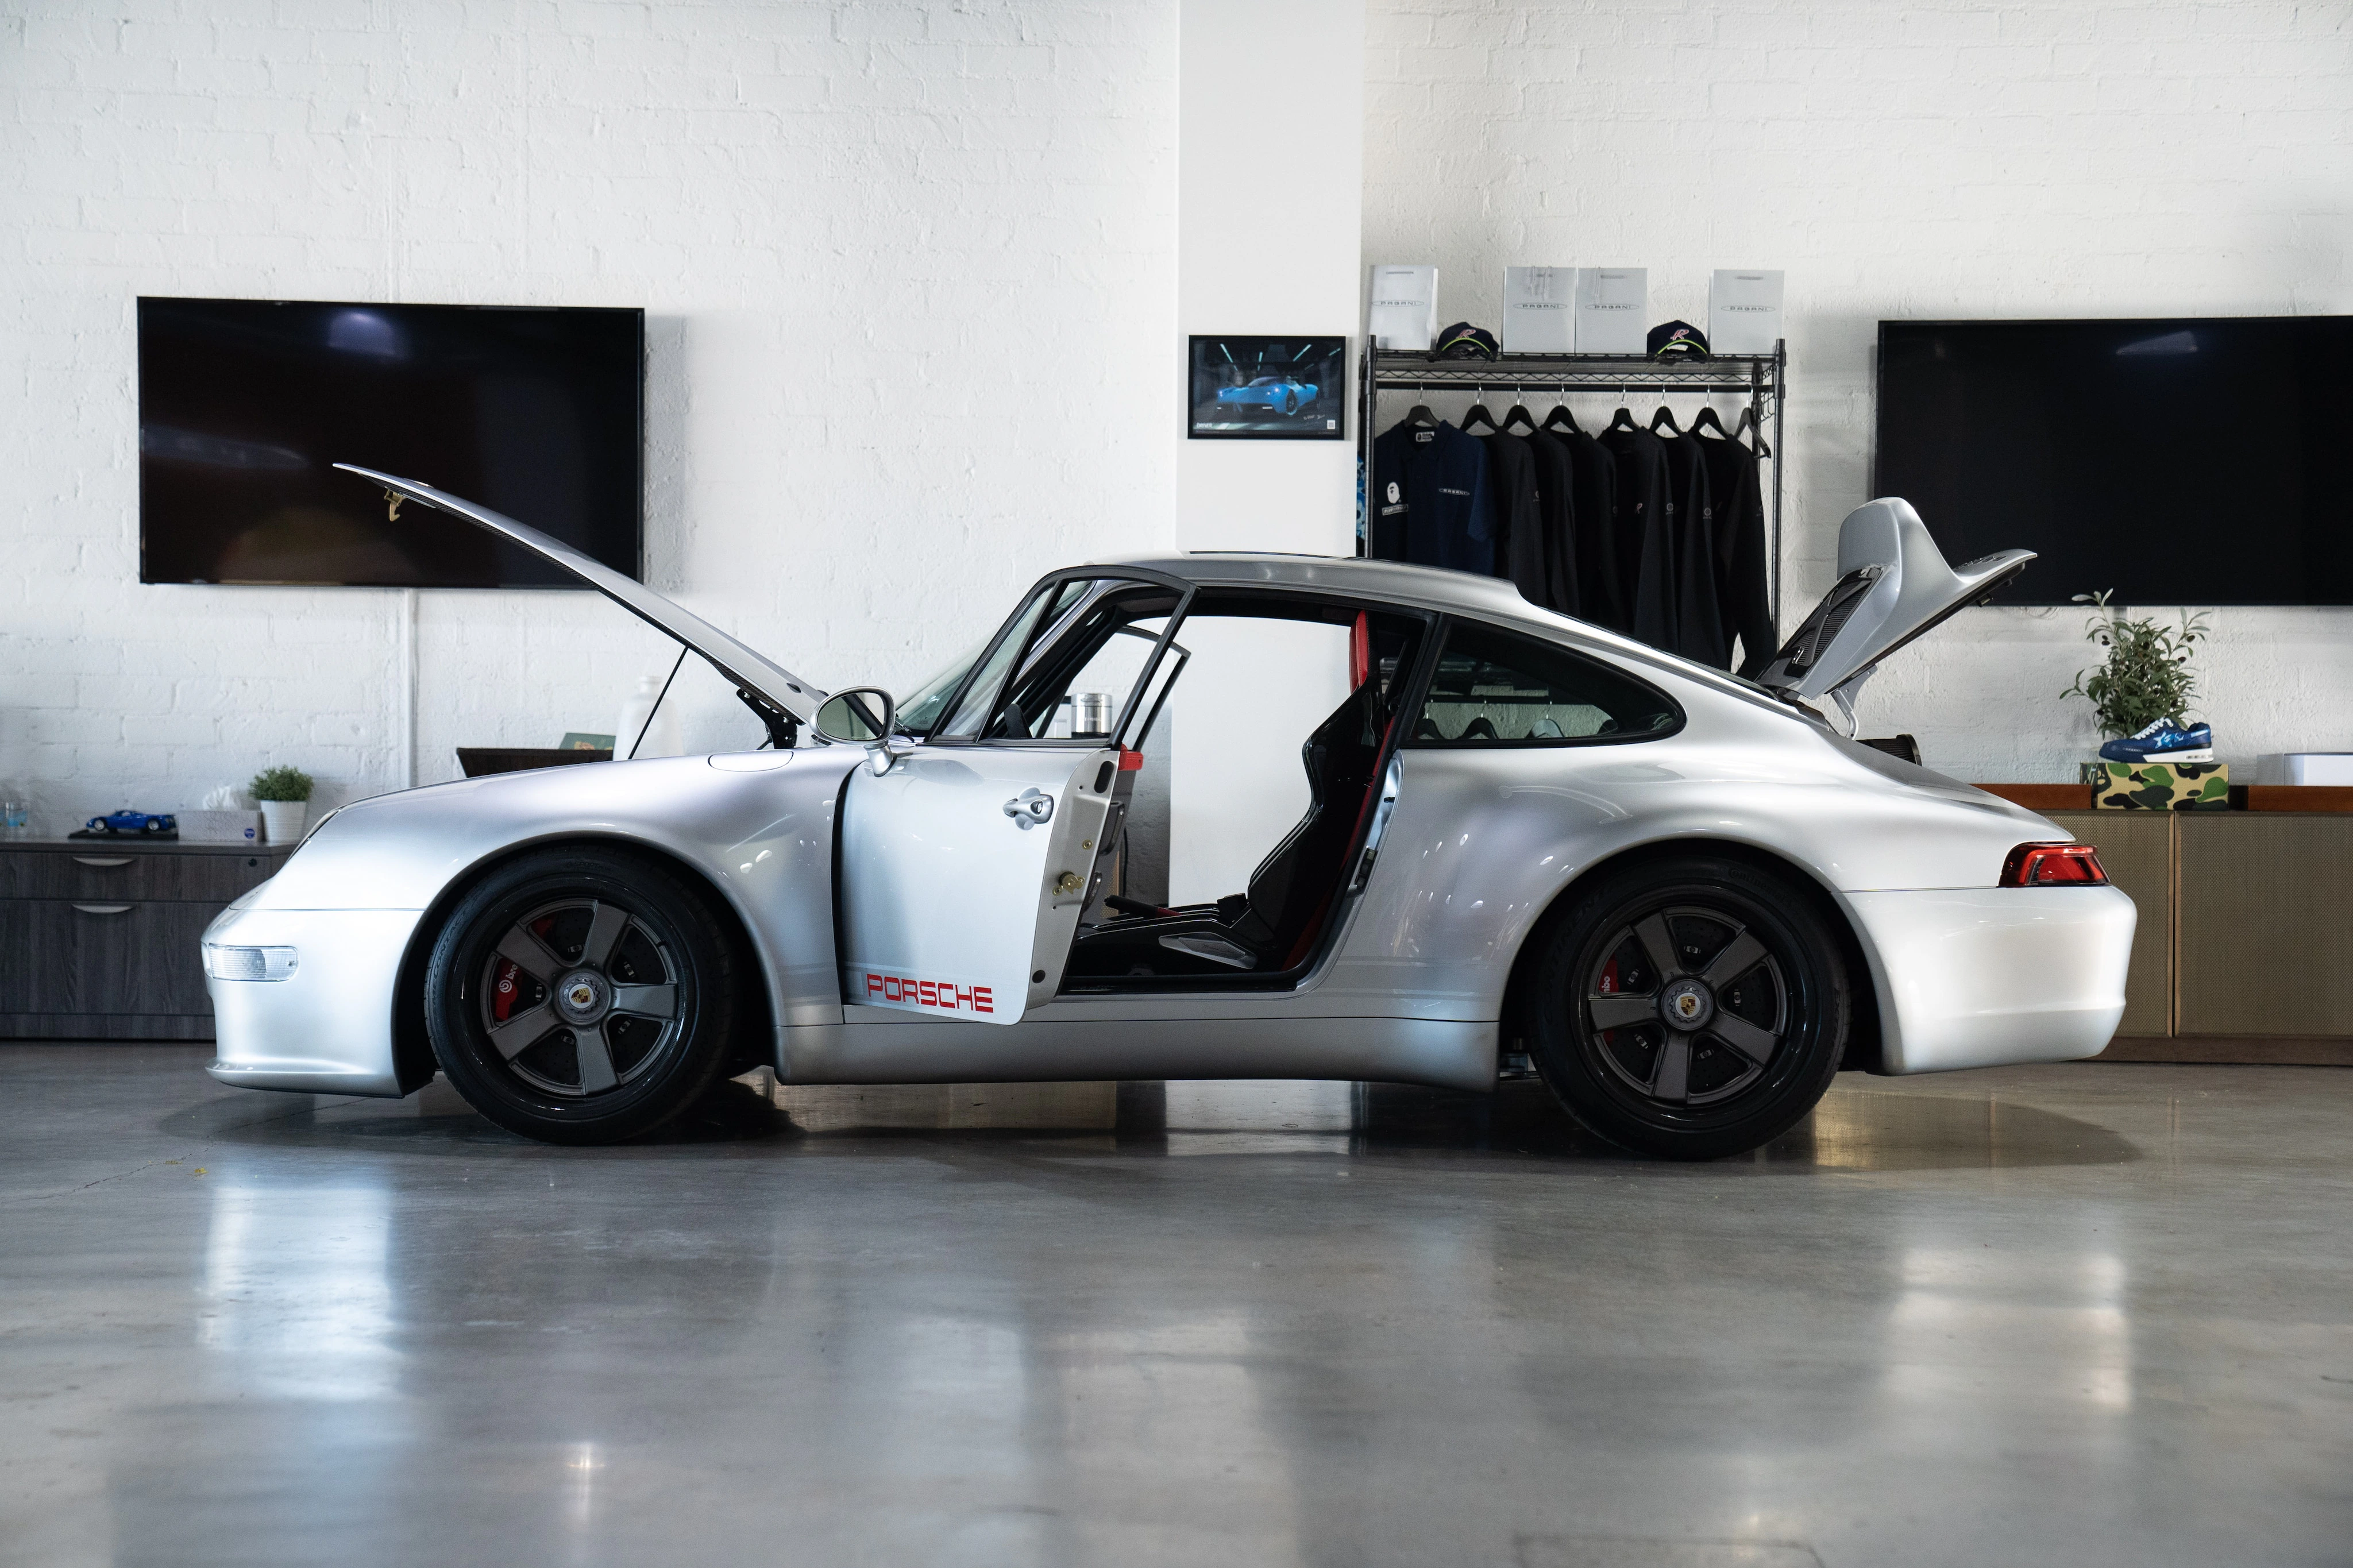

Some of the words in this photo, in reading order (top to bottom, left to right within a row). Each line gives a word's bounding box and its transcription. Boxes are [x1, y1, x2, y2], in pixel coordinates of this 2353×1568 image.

[505, 964, 519, 980] bre
[1601, 976, 1611, 993] mbo
[866, 974, 994, 1013] PORSCHE
